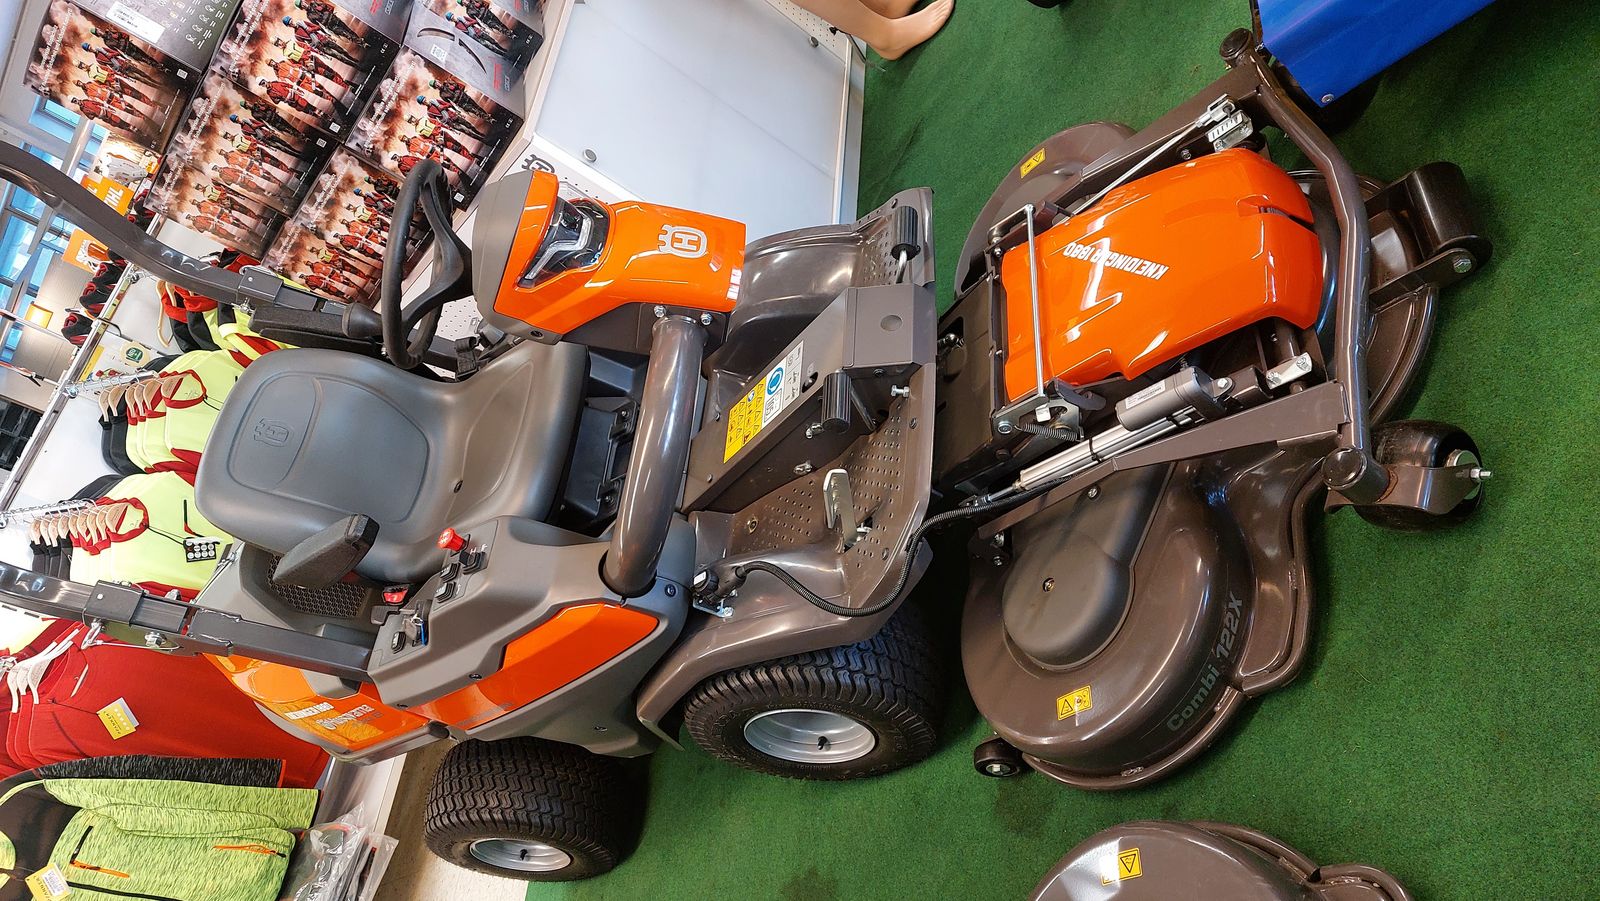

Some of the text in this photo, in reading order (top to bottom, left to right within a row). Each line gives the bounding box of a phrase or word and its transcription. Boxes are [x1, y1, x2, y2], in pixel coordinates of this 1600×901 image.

[103, 187, 123, 206] TIHL
[1062, 242, 1168, 279] KNEIDINGER 1880
[1166, 592, 1243, 731] Combi 122X
